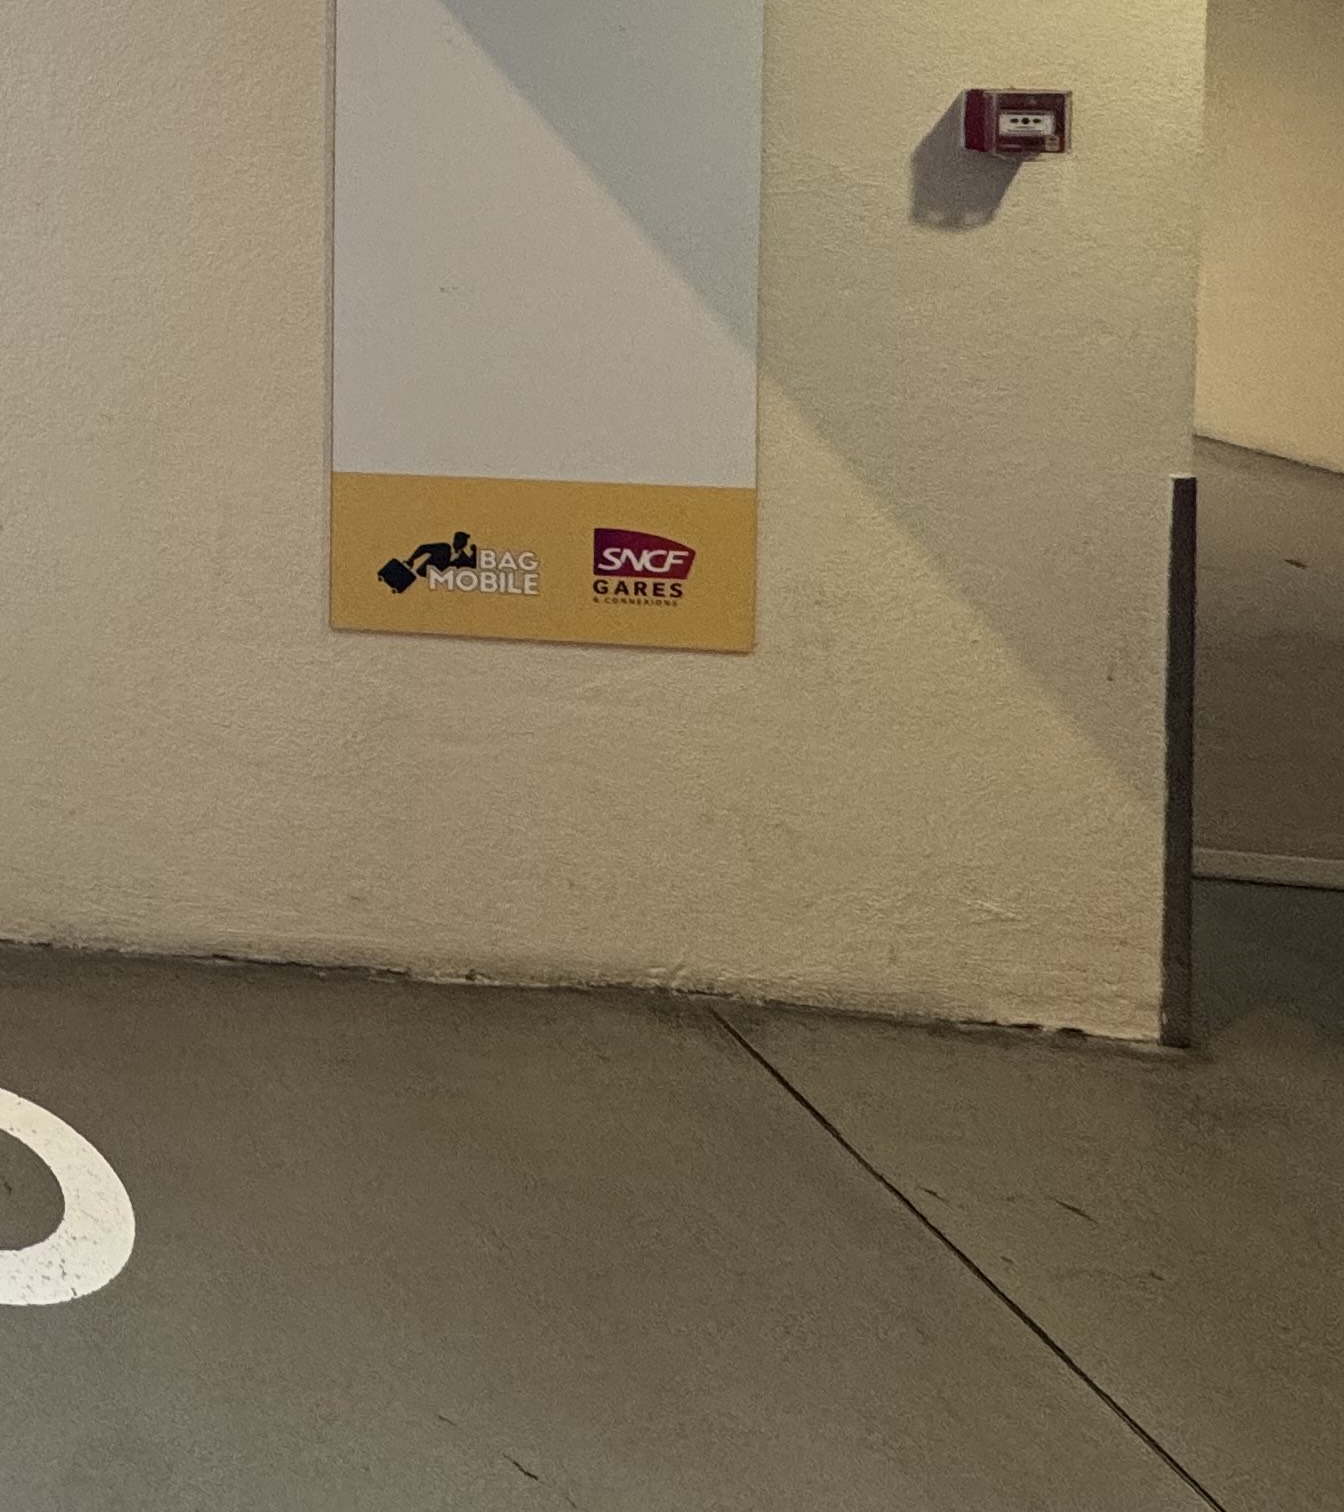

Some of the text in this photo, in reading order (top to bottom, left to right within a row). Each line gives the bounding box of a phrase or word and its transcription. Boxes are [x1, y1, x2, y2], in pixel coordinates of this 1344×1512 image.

[480, 549, 539, 571] BAG
[597, 547, 689, 573] SNCF
[428, 566, 539, 595] MOBILE
[593, 579, 683, 598] GARES
